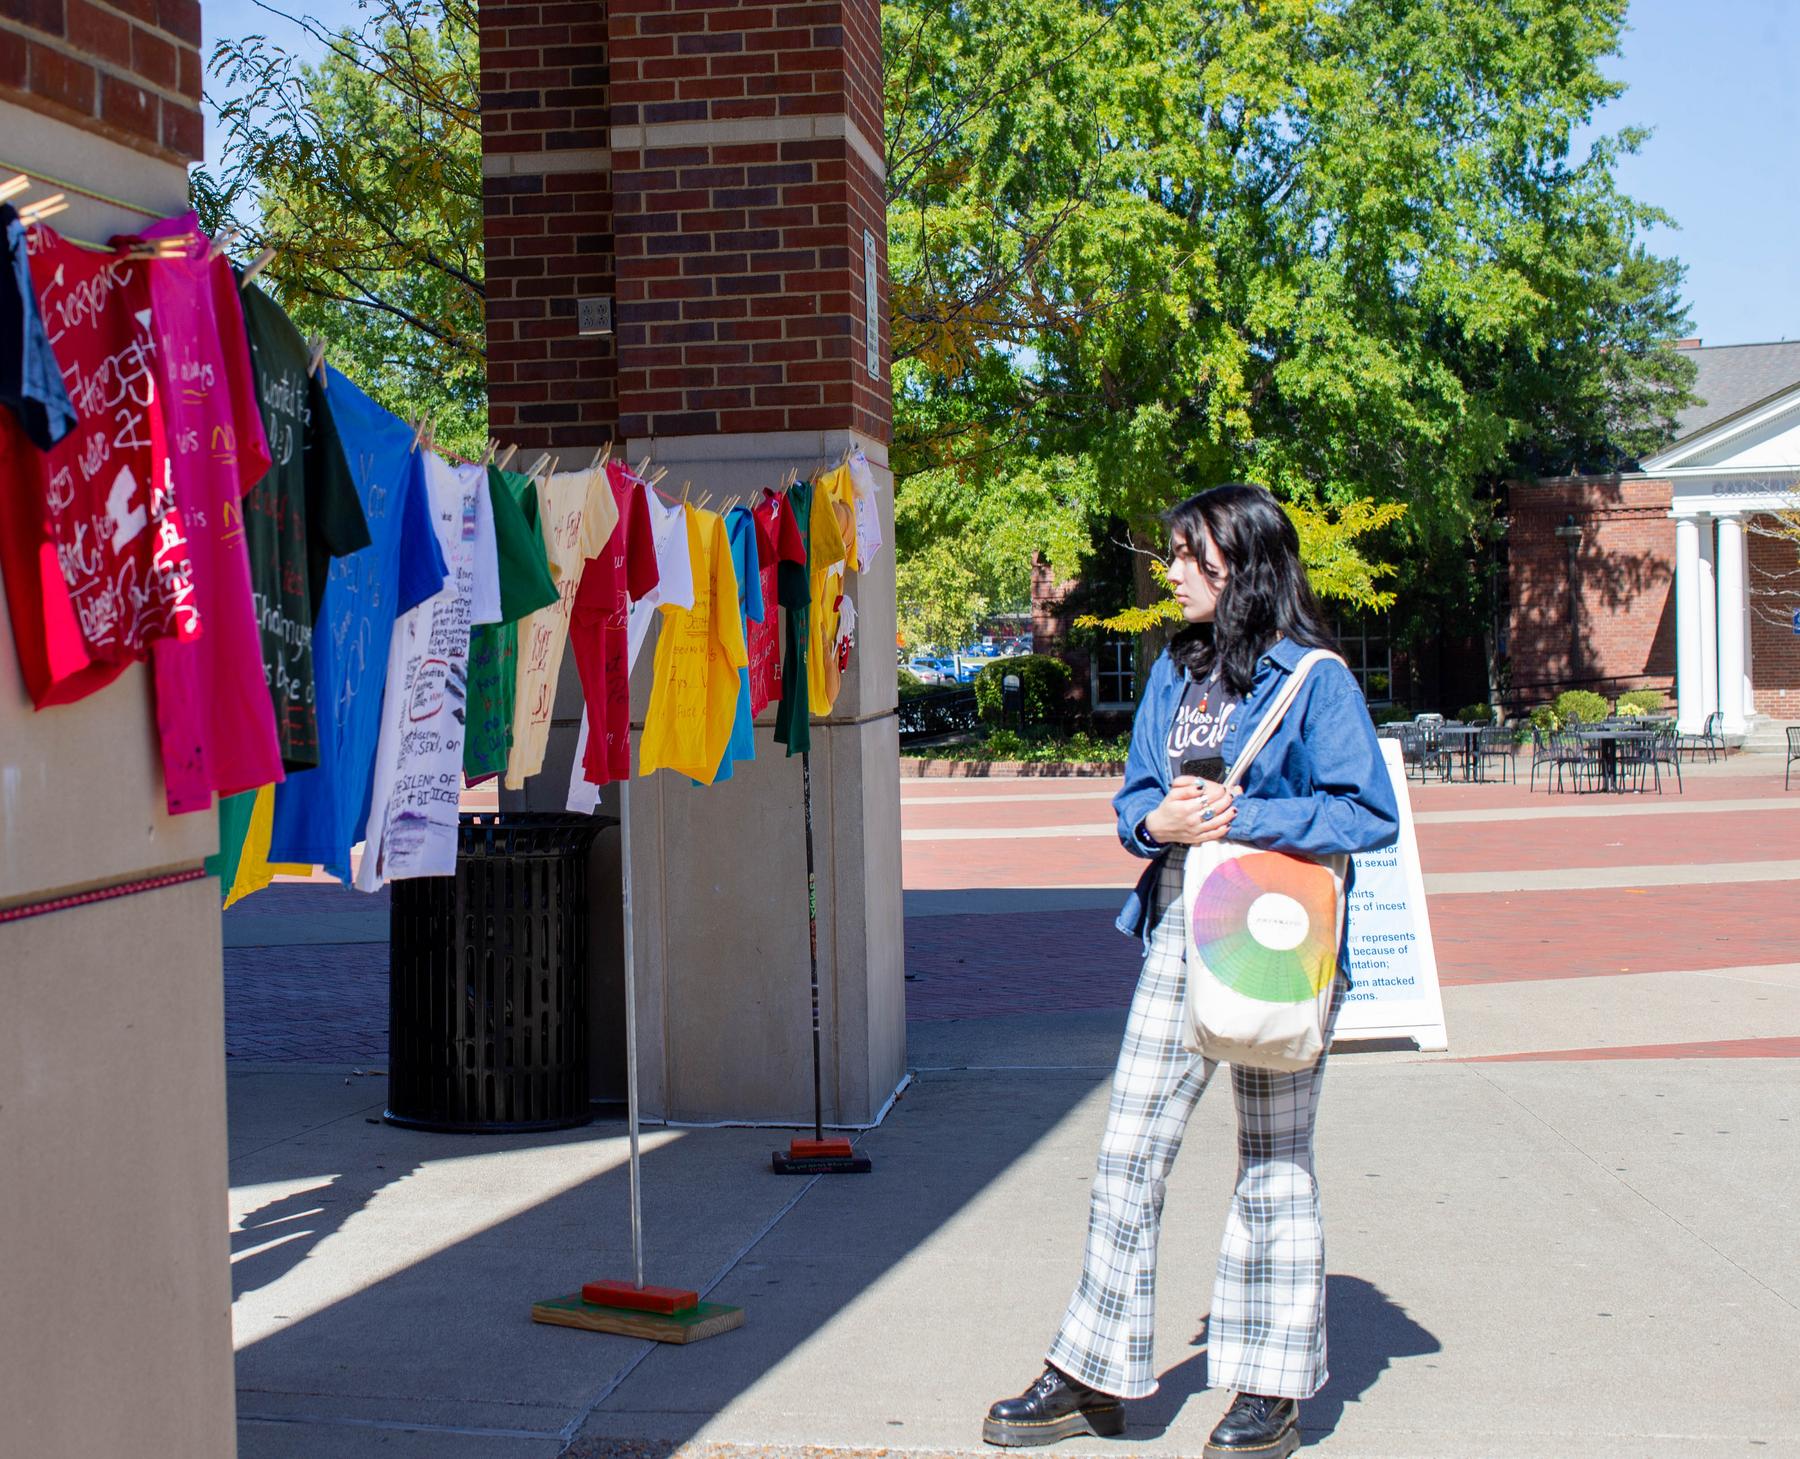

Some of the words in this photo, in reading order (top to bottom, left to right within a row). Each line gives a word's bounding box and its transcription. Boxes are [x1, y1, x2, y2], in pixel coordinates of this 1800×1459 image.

[1364, 857, 1398, 868] sexual
[1363, 901, 1373, 911] of
[1376, 901, 1407, 911] incest
[1361, 932, 1416, 944] represents
[1353, 946, 1396, 956] because
[1398, 944, 1408, 955] of
[1372, 976, 1415, 987] attacked
